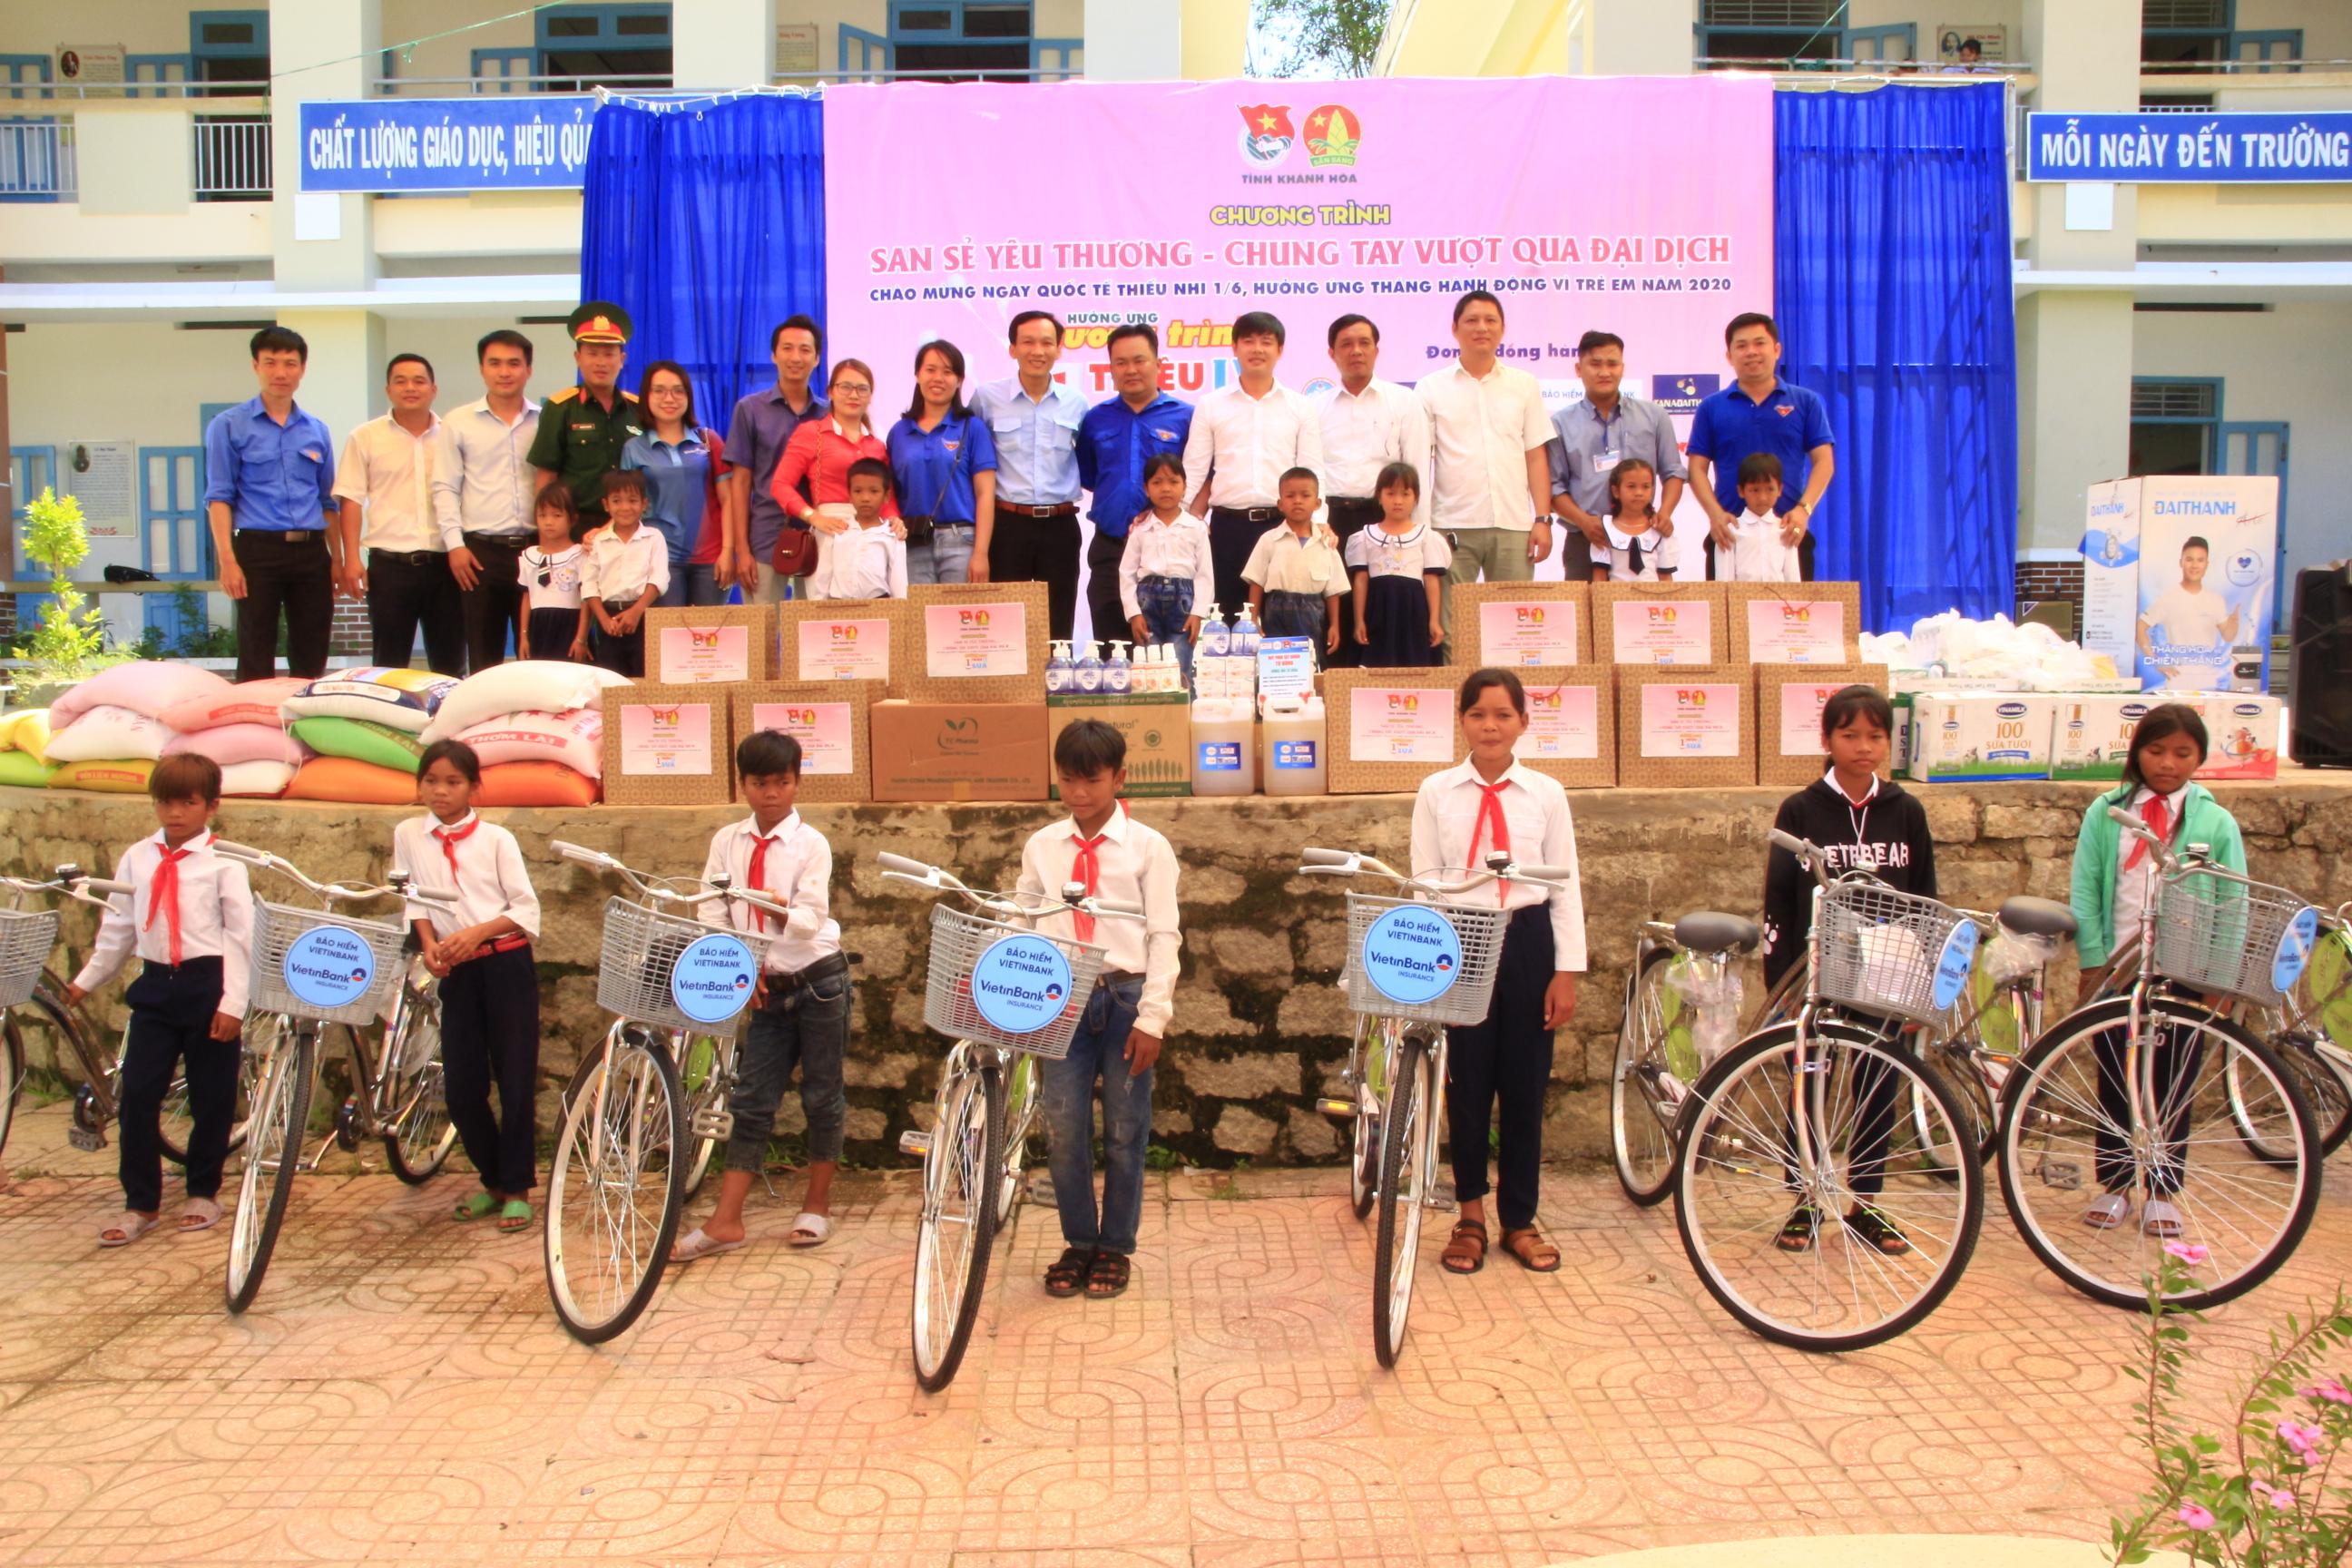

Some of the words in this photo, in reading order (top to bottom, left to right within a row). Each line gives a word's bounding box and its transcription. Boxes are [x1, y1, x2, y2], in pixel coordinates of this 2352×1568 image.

[309, 113, 355, 170] CHẤT
[361, 119, 417, 179] LƯỢNG
[423, 115, 463, 169] GIÁO
[468, 125, 508, 176] DỤC,
[514, 115, 554, 175] HIỆU
[2042, 118, 2090, 167] MỖI
[2100, 124, 2170, 168] NGÀY
[2178, 122, 2231, 168] ĐẾN
[2240, 122, 2349, 168] TRƯỜNG
[1210, 205, 1315, 226] CHƯƠNG
[1318, 200, 1391, 226] TRÌNH
[870, 247, 932, 273] SAN
[943, 237, 976, 271] SẺ
[985, 240, 1043, 270] YÊU
[1053, 240, 1192, 269] THƯƠNG
[1225, 240, 1339, 266] CHUNG
[1351, 240, 1405, 265] TAY
[1414, 238, 1502, 269] VƯỢT
[1513, 238, 1581, 266] QUA
[1591, 238, 1642, 268] ĐẠI
[1654, 238, 1730, 268] DỊCH
[1174, 282, 1206, 295] NHI
[1214, 282, 1248, 297] 1/6,
[1612, 279, 1635, 291] EM
[1688, 278, 1731, 290] 2020
[1167, 319, 1233, 348] trìn
[1548, 342, 1580, 358] hàn
[1996, 721, 2024, 739] 100
[2119, 722, 2135, 740] 10
[1393, 917, 1415, 929] BẢO
[1416, 922, 1440, 935] HIỂM
[316, 936, 335, 946] BẢO
[337, 940, 358, 951] HIỂM
[1387, 930, 1443, 946] VIETINBANK
[309, 946, 359, 962] VIETINBANK
[700, 946, 717, 956] BẢO
[720, 947, 740, 958] HIỂM
[1005, 946, 1027, 958] BẢO
[1029, 951, 1053, 964] HIỂM
[694, 959, 740, 968] VIETINBANK
[999, 959, 1054, 976] VIETINBANK
[1371, 951, 1436, 973] VietinBank
[291, 962, 351, 984] VietinBank
[680, 980, 735, 992] VietinBank
[981, 980, 1045, 1002] VietinBank
